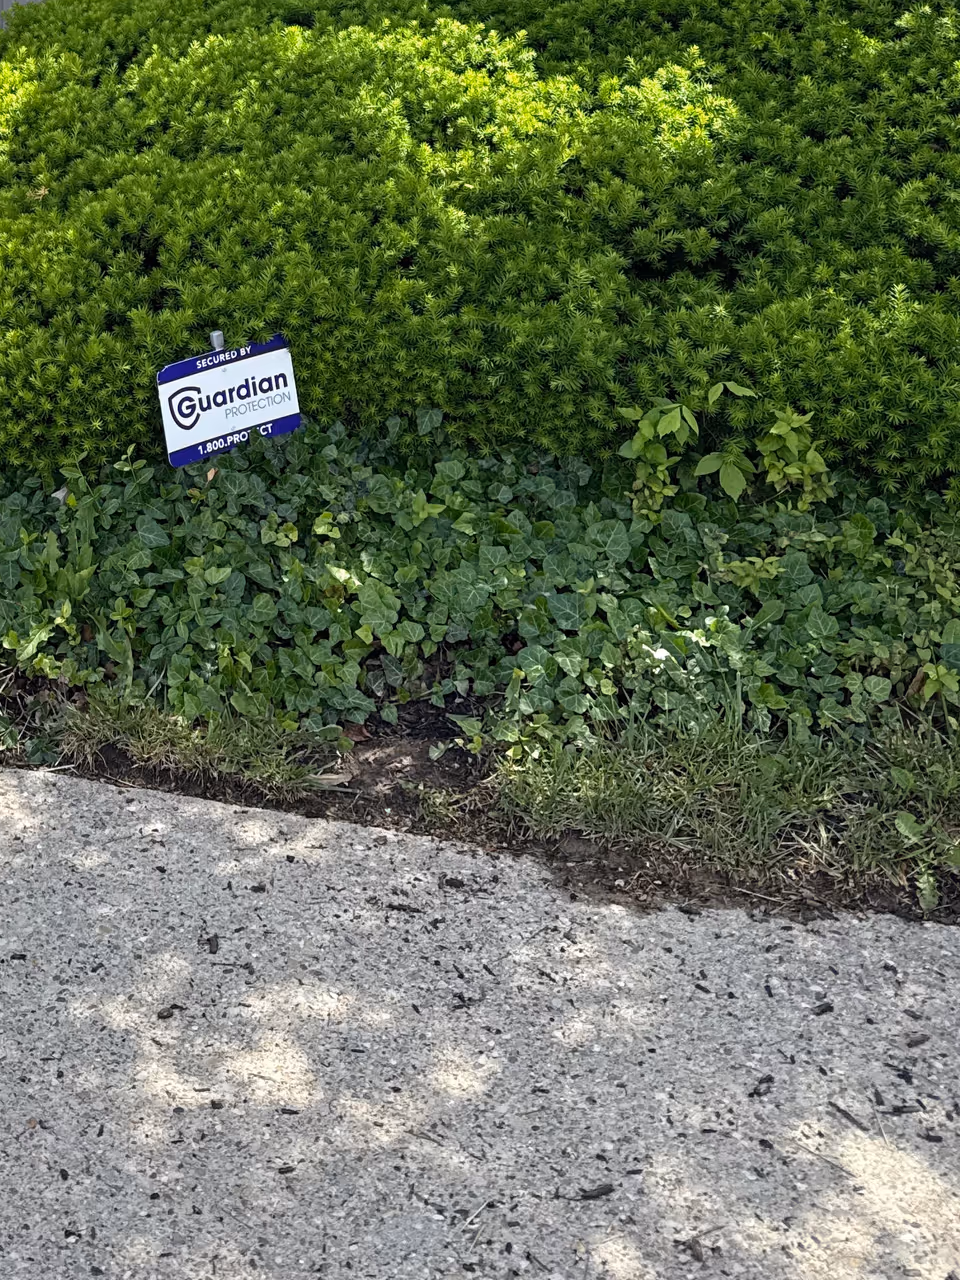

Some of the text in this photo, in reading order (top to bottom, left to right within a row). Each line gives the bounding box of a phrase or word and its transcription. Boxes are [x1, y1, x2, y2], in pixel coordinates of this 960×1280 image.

[196, 345, 252, 369] SECURED BY
[176, 372, 288, 419] Guardian
[225, 391, 291, 419] PROTECTION
[197, 423, 273, 455] 1.800.PROCT
